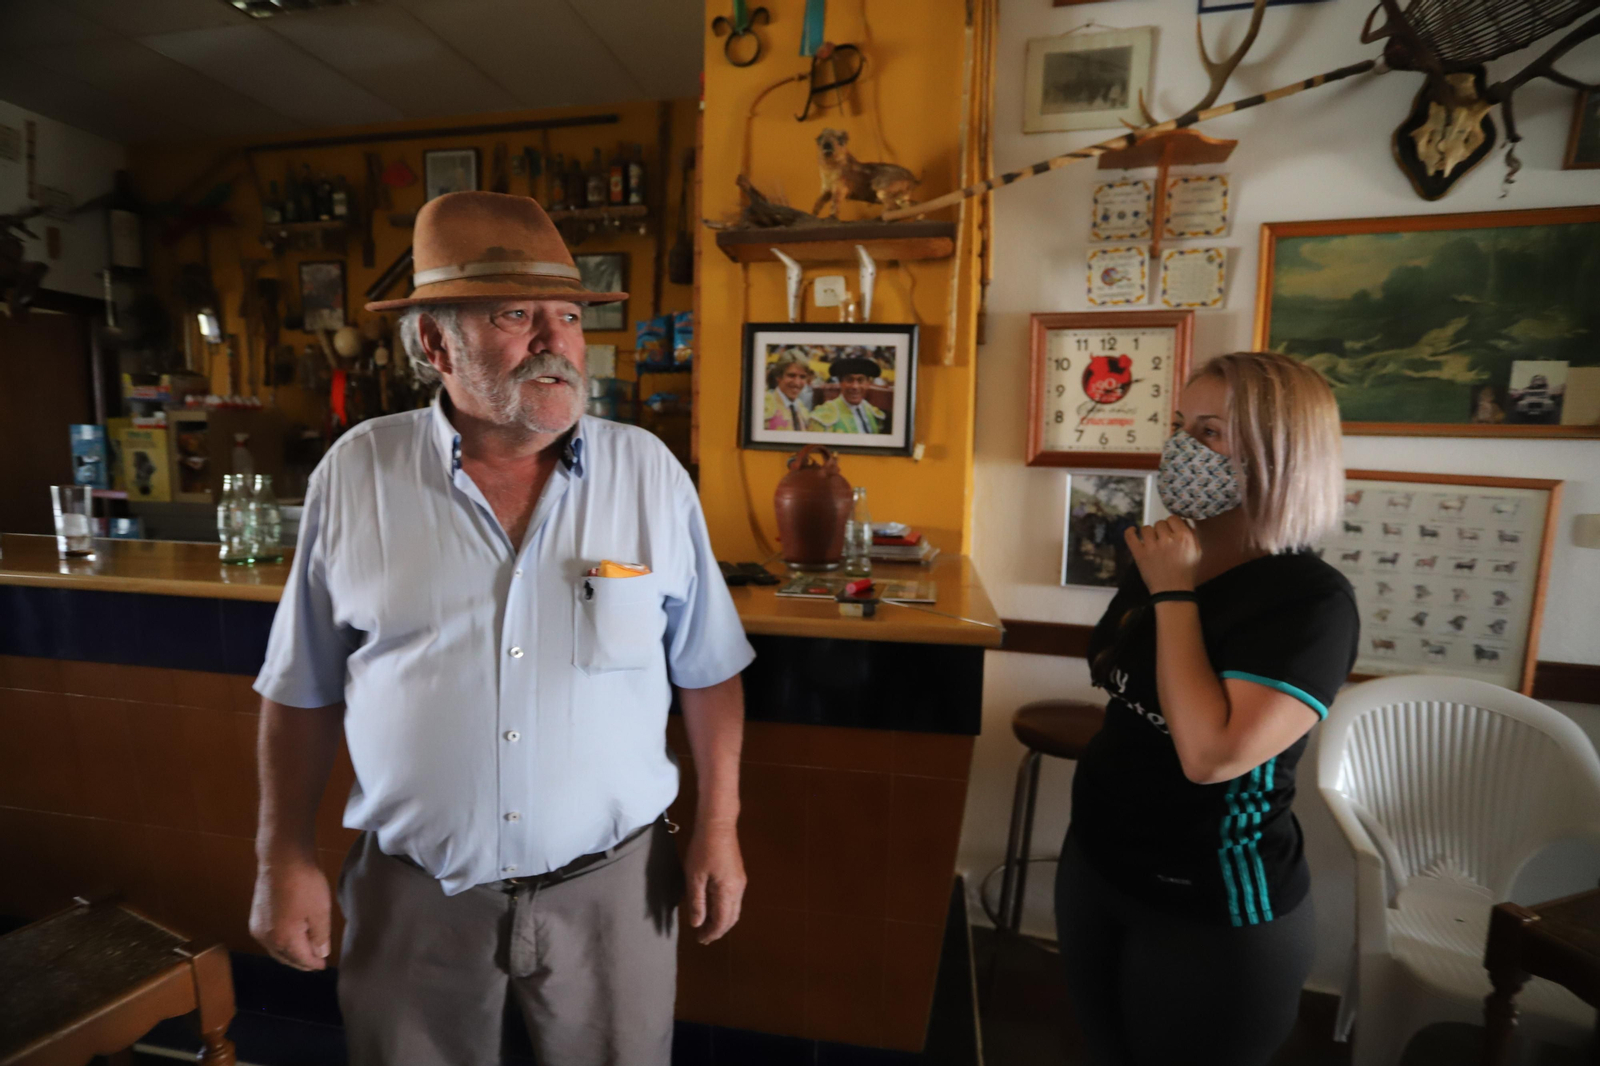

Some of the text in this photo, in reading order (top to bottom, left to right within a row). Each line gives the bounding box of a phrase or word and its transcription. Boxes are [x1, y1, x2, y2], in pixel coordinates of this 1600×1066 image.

[1076, 338, 1089, 351] 11
[1100, 337, 1118, 351] 12
[1133, 338, 1139, 350] 1
[1054, 358, 1071, 371] 10
[1152, 356, 1162, 370] 2
[1056, 385, 1065, 397] 9
[1151, 385, 1161, 398] 3
[1055, 411, 1064, 423] 8
[1148, 412, 1158, 424] 4
[1075, 430, 1084, 442] 7
[1099, 433, 1109, 445] 6
[1127, 430, 1136, 443] 5
